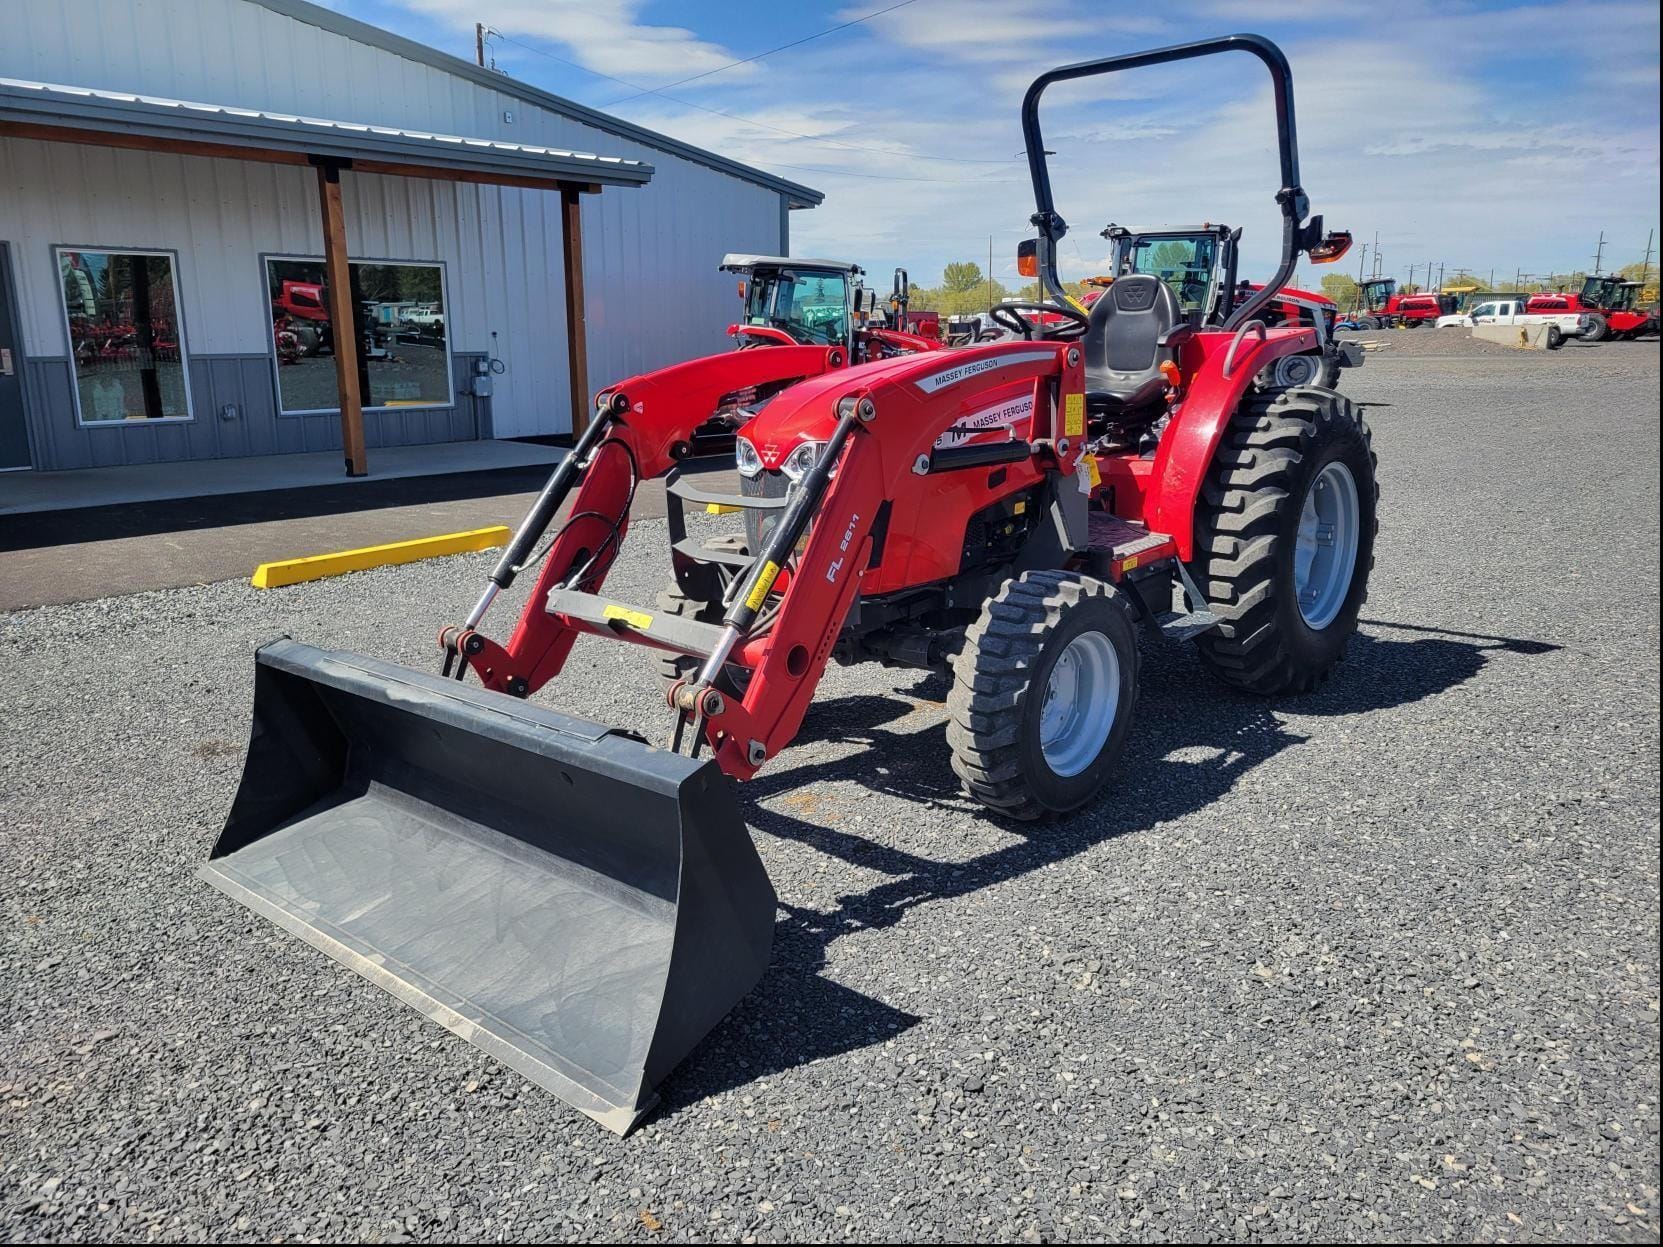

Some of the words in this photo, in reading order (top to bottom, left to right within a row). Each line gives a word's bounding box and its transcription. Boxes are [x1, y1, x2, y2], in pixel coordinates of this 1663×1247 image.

[935, 368, 963, 387] MASSEY
[965, 359, 998, 376] FERGUSON
[973, 412, 1001, 429] MASSEY
[1003, 401, 1033, 418] FERGUSO
[826, 557, 844, 583] FL
